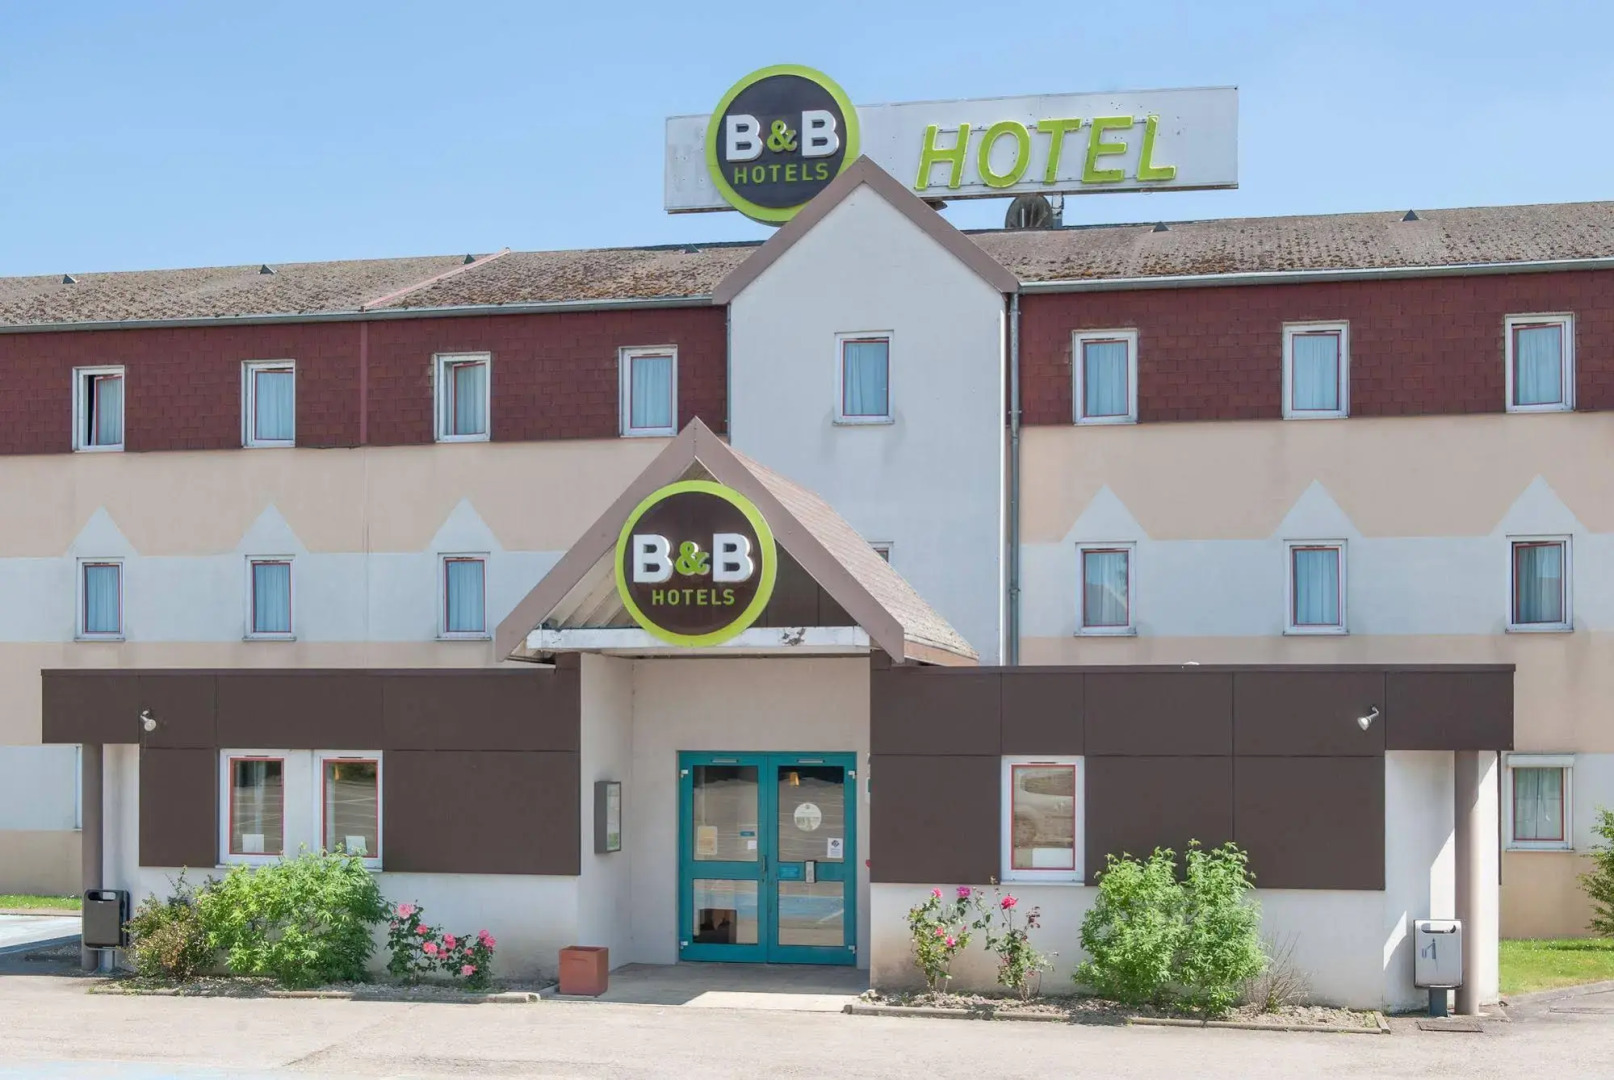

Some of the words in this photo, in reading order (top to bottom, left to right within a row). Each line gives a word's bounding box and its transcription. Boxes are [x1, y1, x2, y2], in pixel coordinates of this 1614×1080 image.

[726, 110, 839, 162] B&B
[914, 115, 1177, 190] HOTEL
[733, 162, 829, 185] HOTELS
[633, 533, 753, 583] B&B
[652, 589, 735, 605] HOTELS
